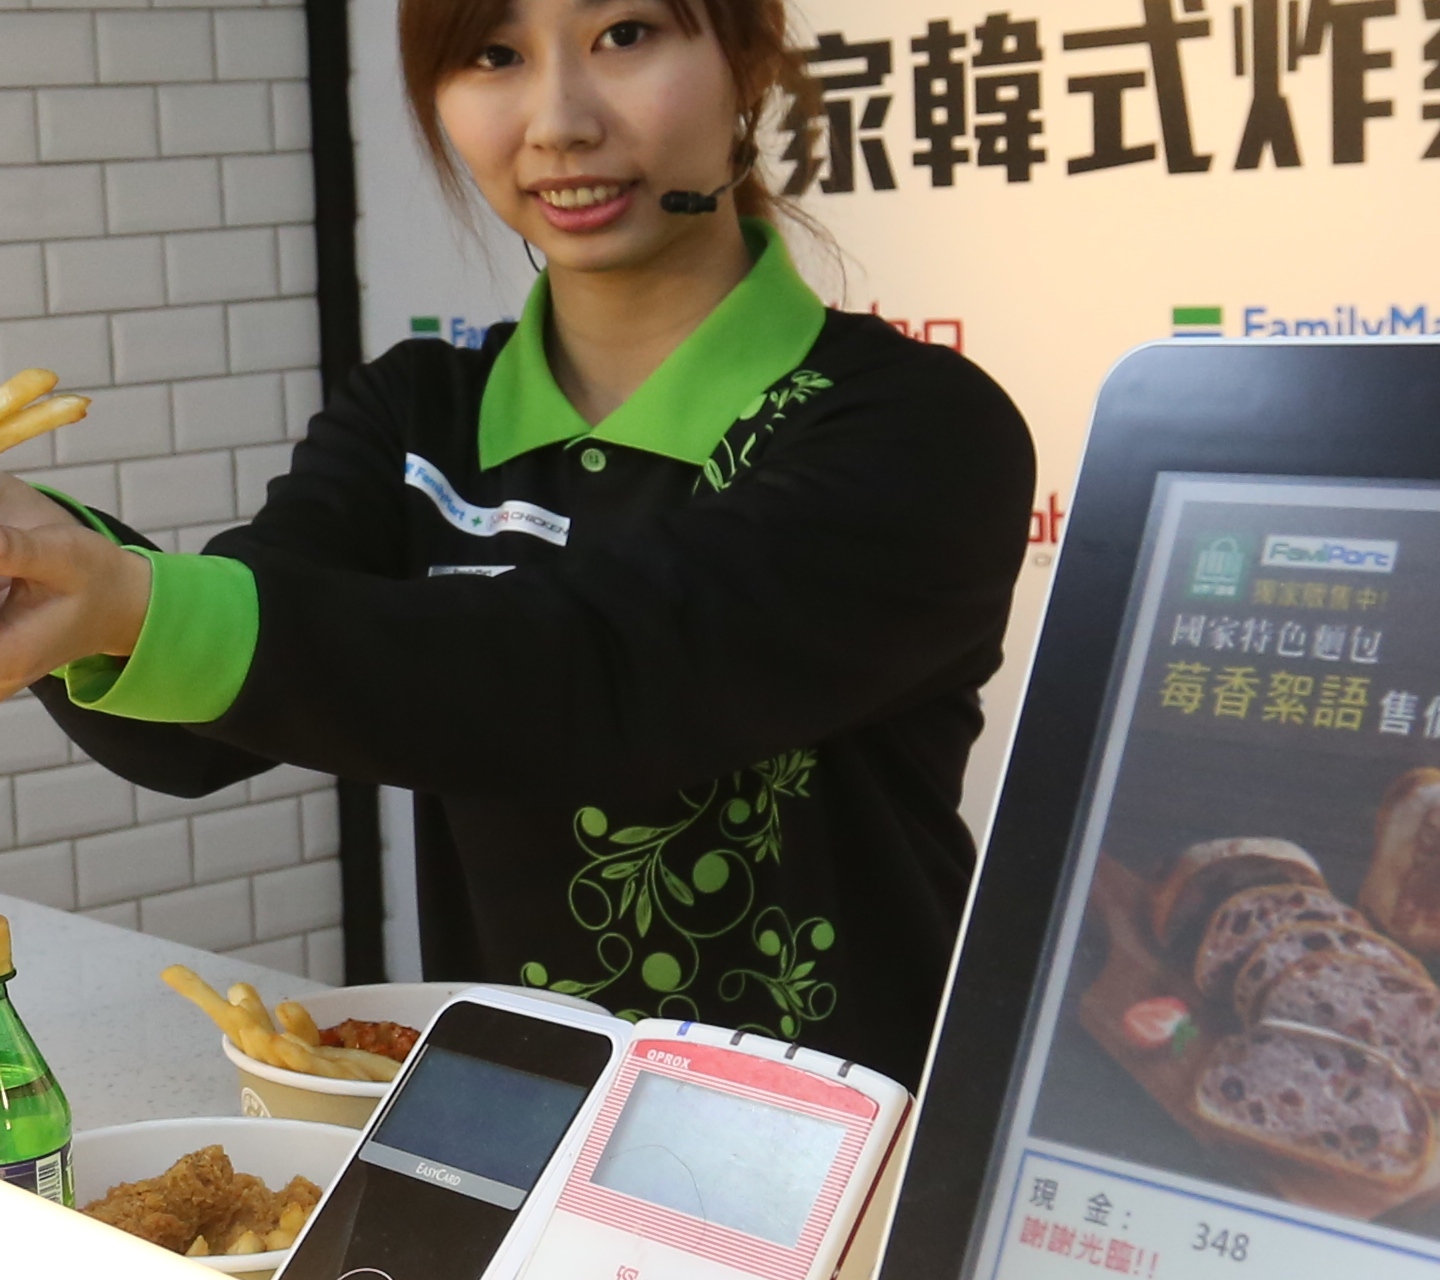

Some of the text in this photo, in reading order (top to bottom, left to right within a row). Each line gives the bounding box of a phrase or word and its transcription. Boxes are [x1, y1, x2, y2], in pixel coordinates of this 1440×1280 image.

[1159, 661, 1371, 733] 莓香絮語
[645, 1048, 693, 1070] QPROX
[1191, 1222, 1251, 1264] 348
